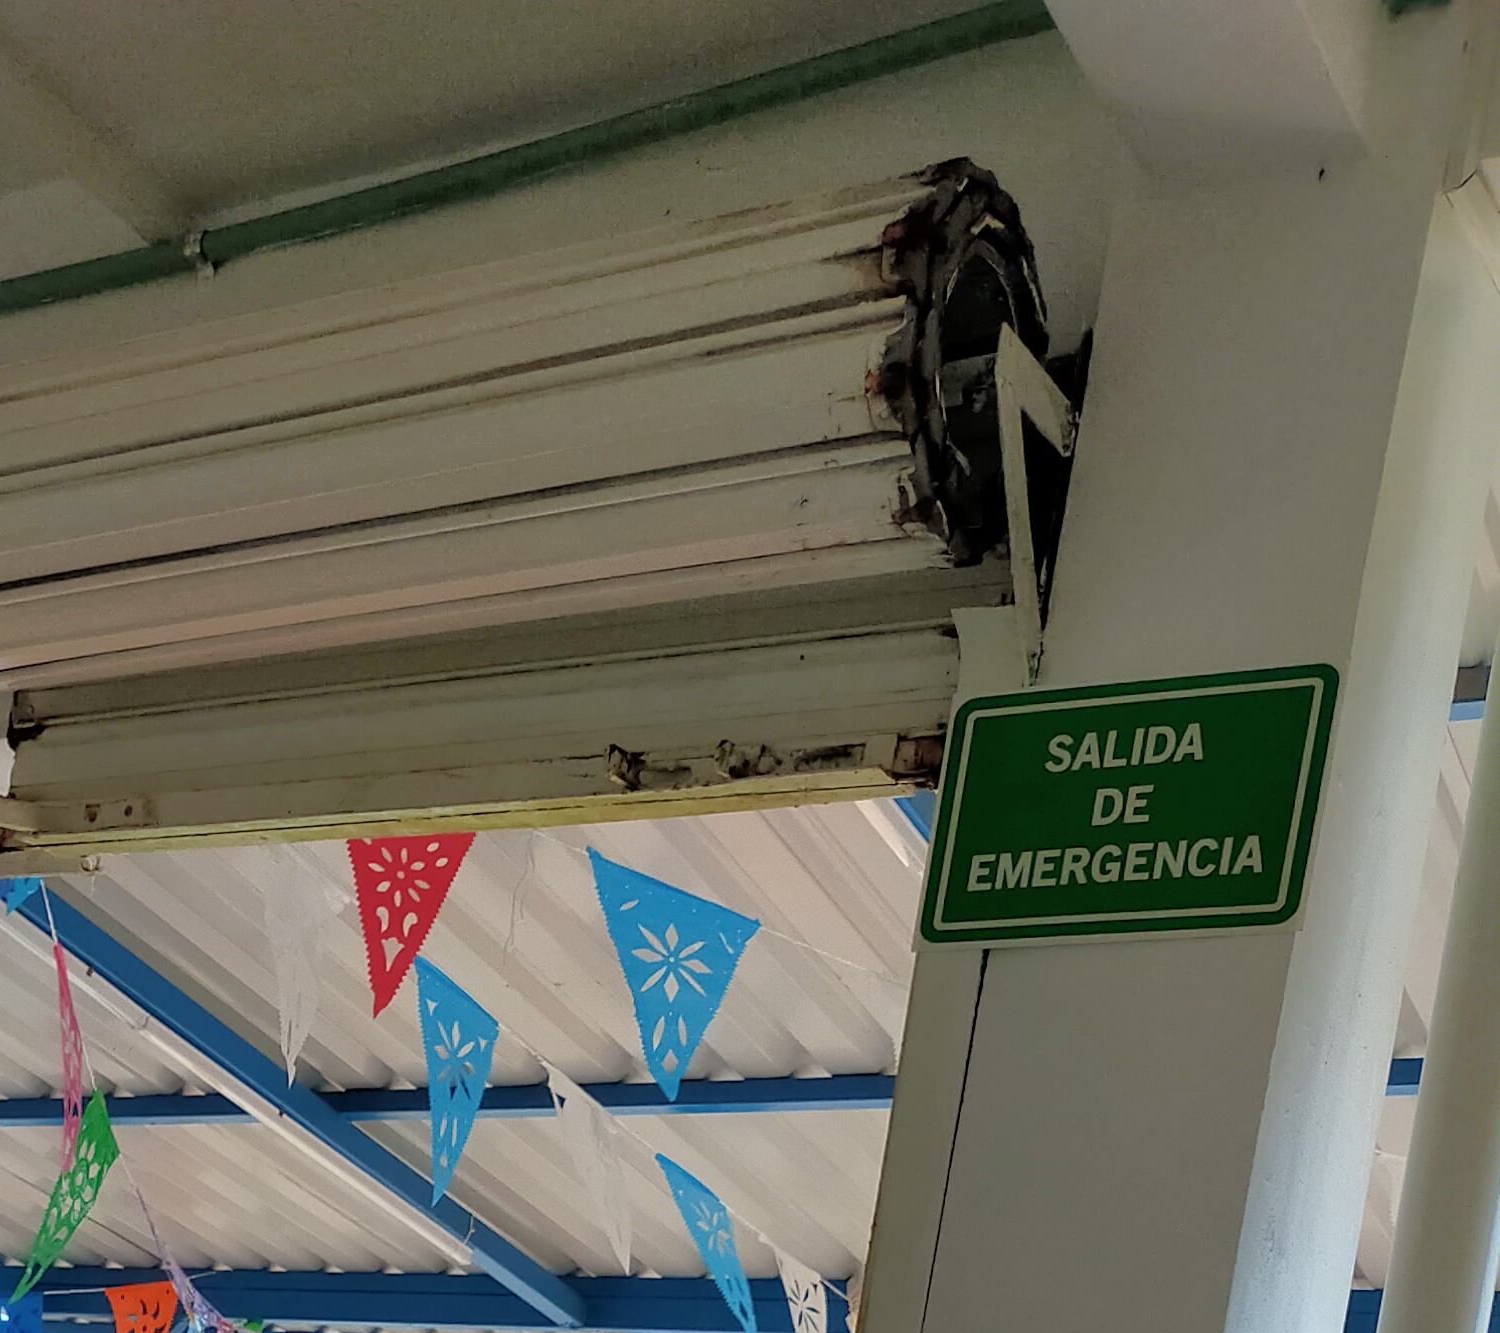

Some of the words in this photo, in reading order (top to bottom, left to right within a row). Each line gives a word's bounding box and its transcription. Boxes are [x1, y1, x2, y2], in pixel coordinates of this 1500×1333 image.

[1044, 722, 1205, 774] SALIDA
[1091, 784, 1155, 827] DE
[966, 834, 1264, 892] EMERGENCIA
